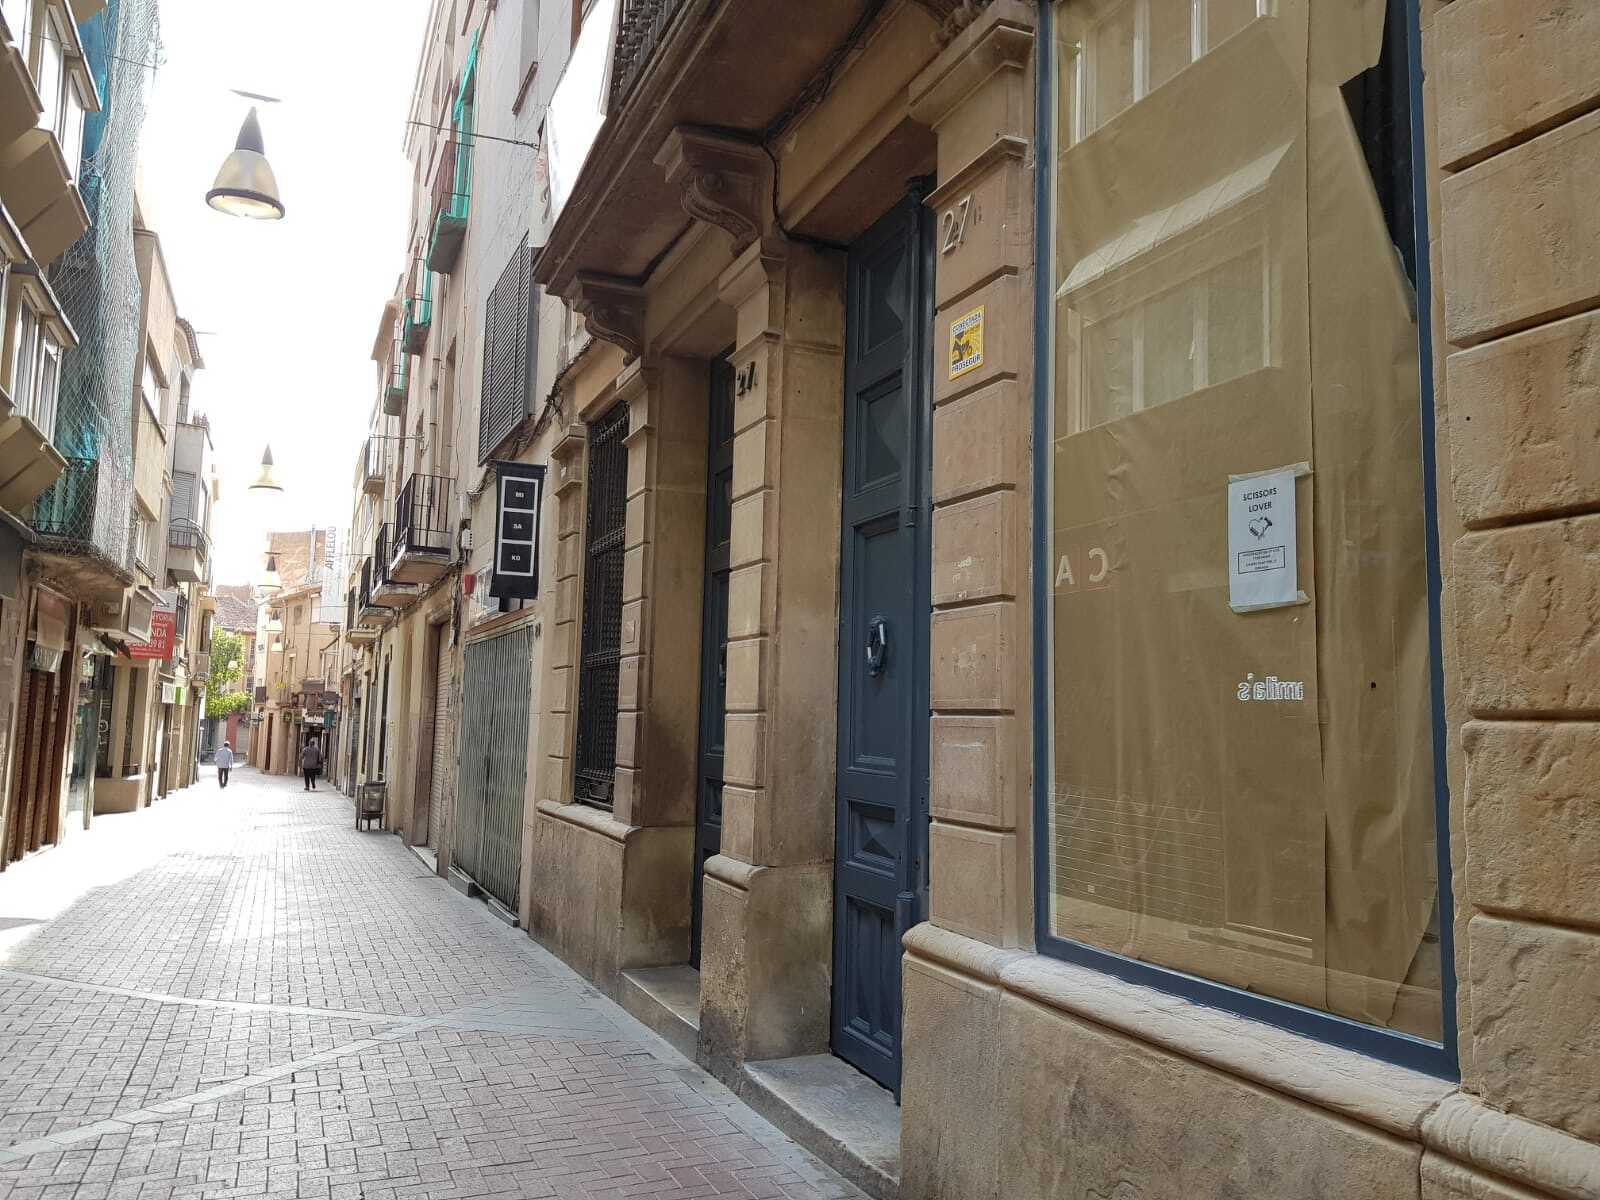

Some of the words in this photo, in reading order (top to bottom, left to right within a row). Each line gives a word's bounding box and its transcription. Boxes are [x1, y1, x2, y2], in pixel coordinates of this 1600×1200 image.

[941, 193, 976, 253] 27
[952, 352, 981, 372] PROSEGUR
[736, 361, 757, 397] 27
[1242, 487, 1278, 501] SCISSORS
[1248, 501, 1273, 513] LOVER
